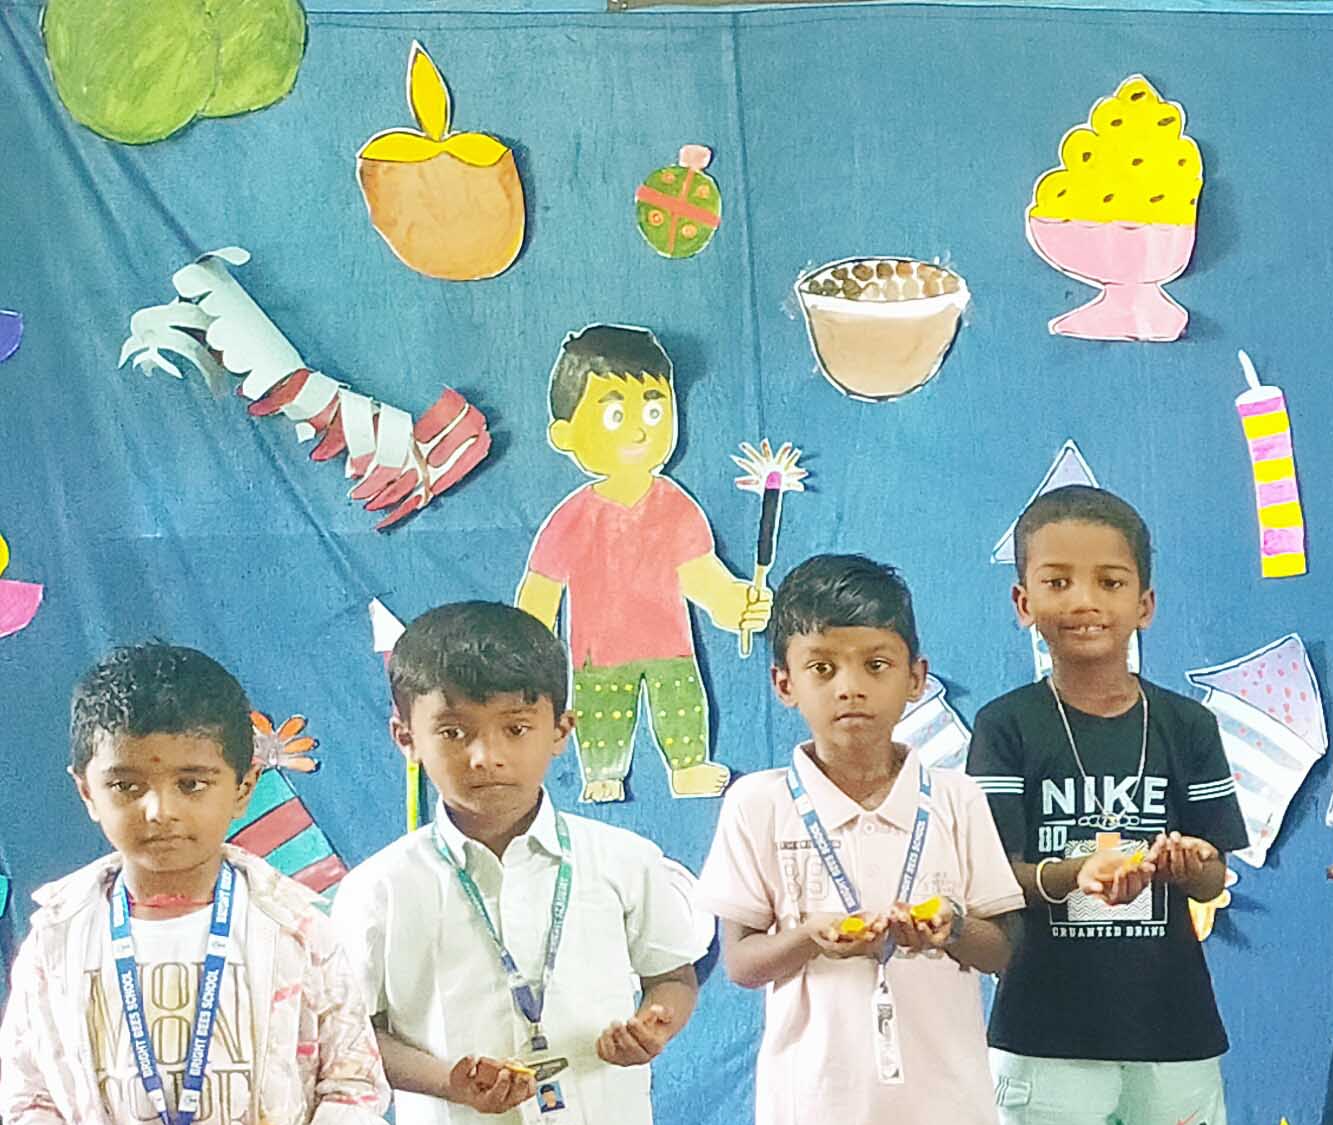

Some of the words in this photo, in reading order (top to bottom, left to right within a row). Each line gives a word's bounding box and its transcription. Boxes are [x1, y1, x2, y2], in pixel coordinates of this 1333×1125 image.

[1042, 775, 1169, 815] NIKE
[120, 970, 139, 1011] SCHOOL
[201, 969, 220, 1010] SCHOOL
[128, 1011, 145, 1039] BEES
[196, 1010, 212, 1036] BEES
[135, 1039, 155, 1077] BRIGHT
[189, 1034, 208, 1077] BRIGHT
